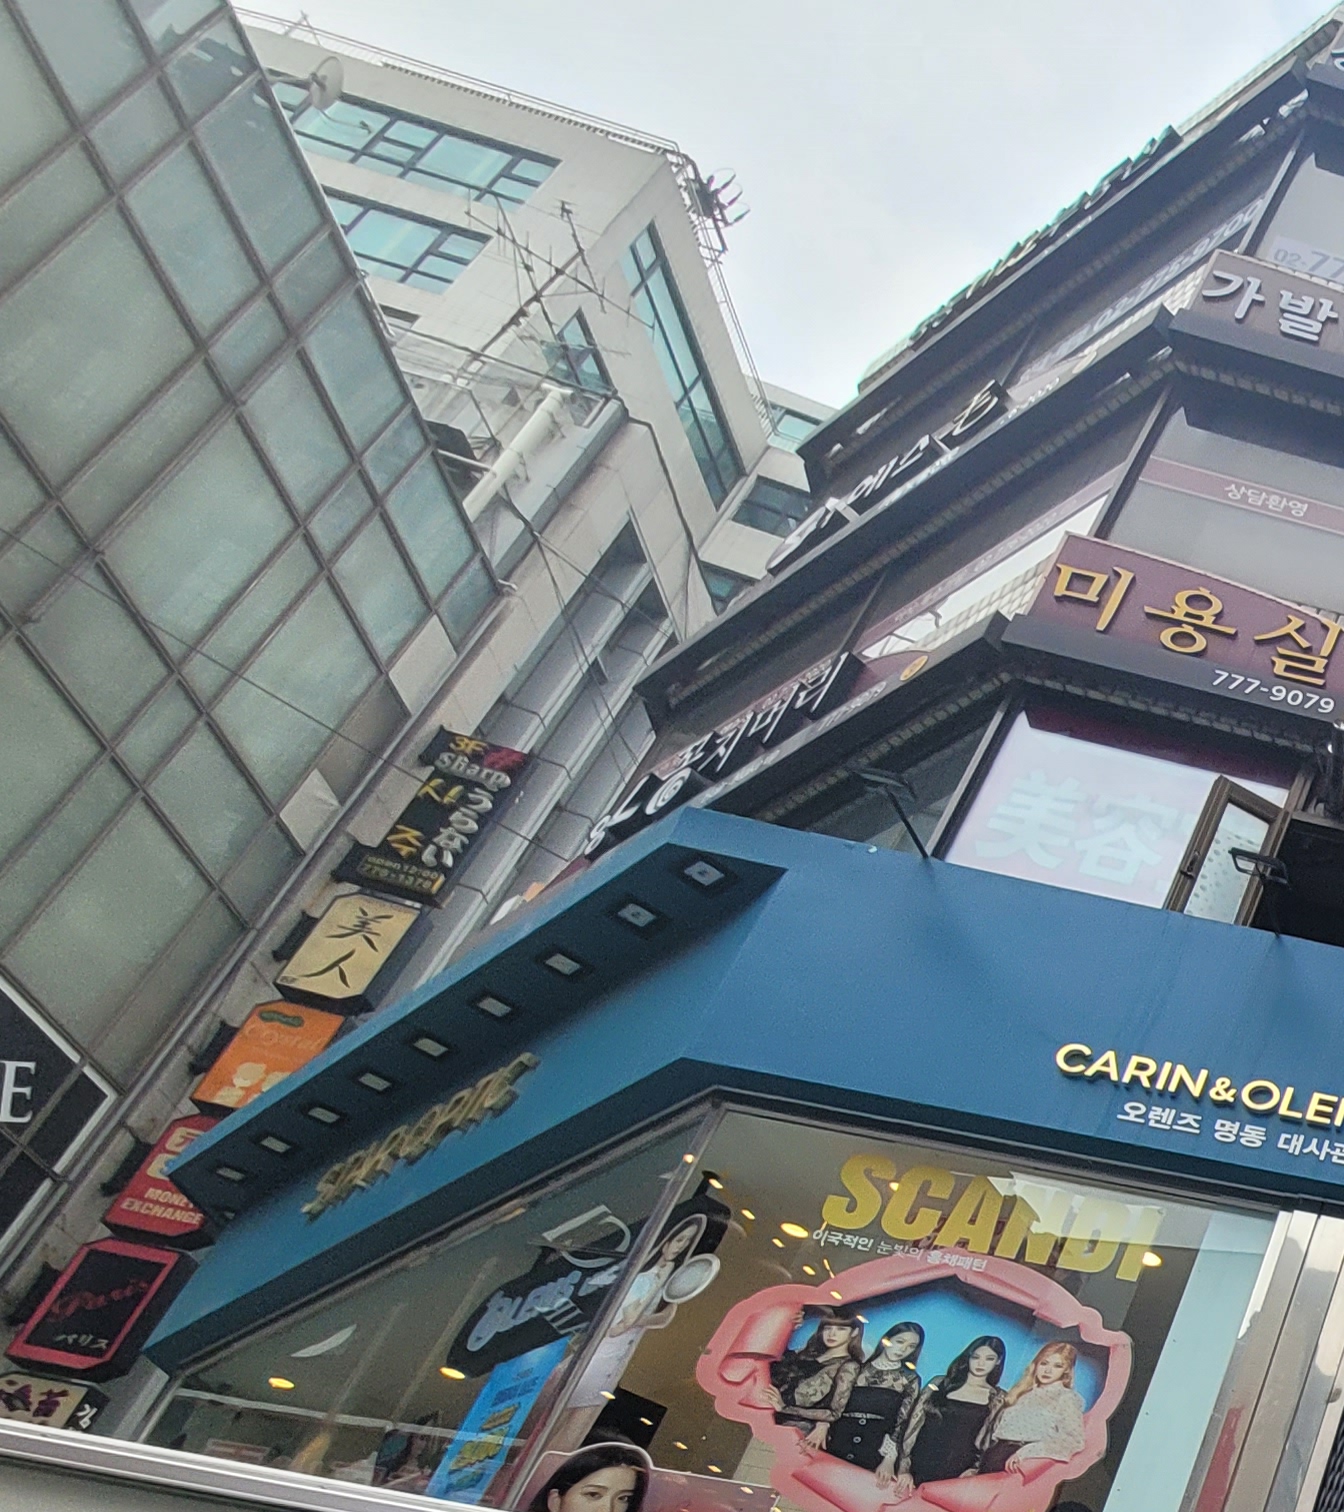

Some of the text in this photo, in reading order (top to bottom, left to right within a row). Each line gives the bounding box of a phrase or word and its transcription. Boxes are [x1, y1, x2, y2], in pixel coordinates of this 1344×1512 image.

[1224, 482, 1309, 517] 상담환영
[1054, 563, 1343, 687] 미용실
[1211, 669, 1335, 714] 777-9079
[304, 906, 394, 988] 美人
[1116, 1101, 1203, 1134] 오렌즈
[1213, 1118, 1267, 1148] 명동
[121, 1200, 204, 1225] EXCHANGE
[821, 1153, 1165, 1282] SCANDI
[812, 1228, 875, 1253] 이국적인
